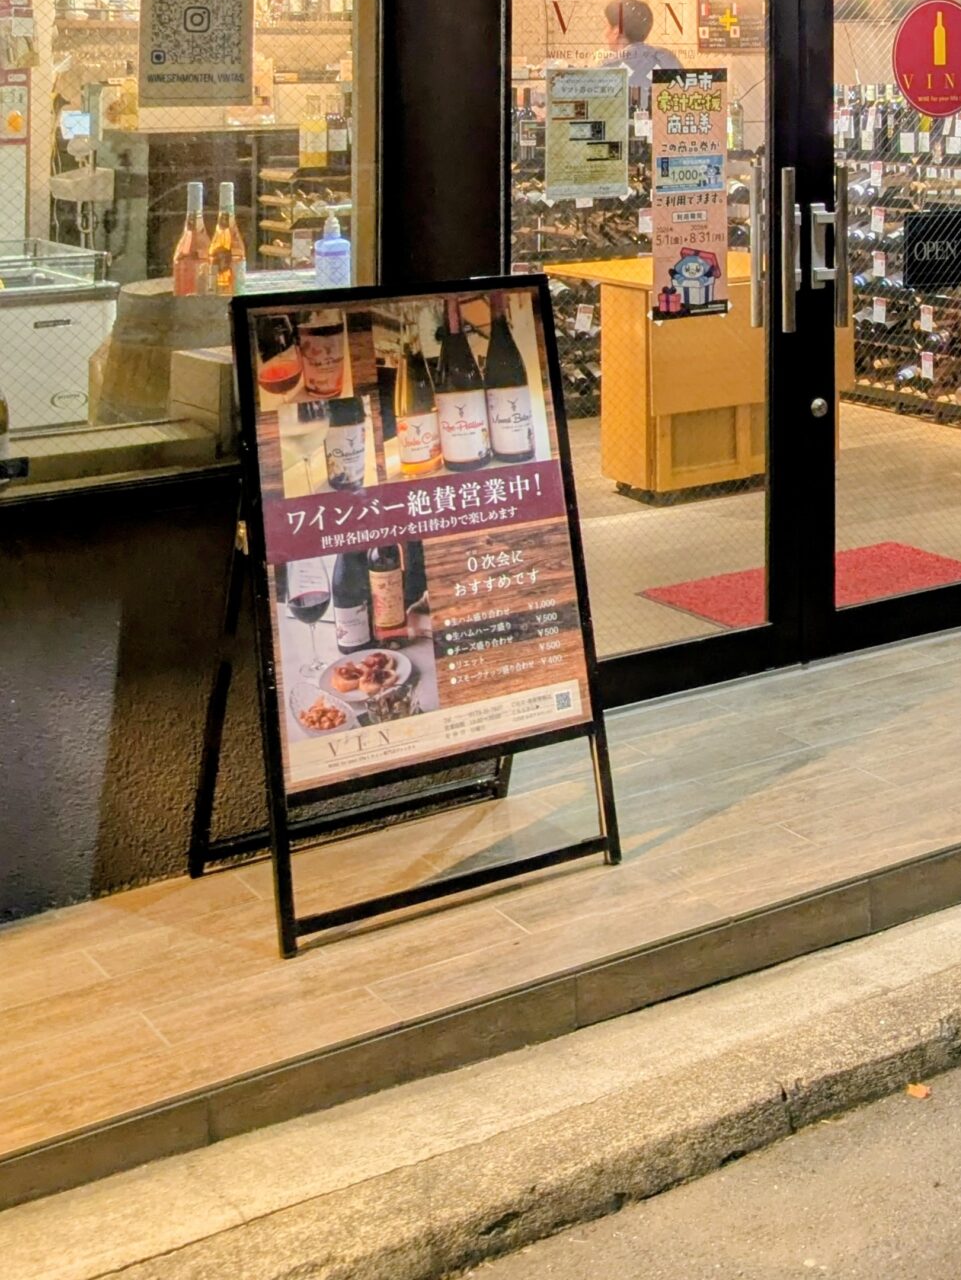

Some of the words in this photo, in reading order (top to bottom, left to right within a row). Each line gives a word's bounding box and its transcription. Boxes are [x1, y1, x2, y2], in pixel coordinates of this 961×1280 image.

[549, 50, 572, 60] WINE
[574, 50, 589, 60] for
[668, 72, 713, 91] 八戸市
[657, 89, 722, 113] 家計応援
[667, 112, 713, 135] 商品券
[661, 141, 720, 153] この商品券が
[656, 193, 723, 207] ご利用できます。
[914, 241, 957, 261] OPEN
[320, 506, 518, 549] 世界各国のワインを日替わりで楽しめます
[454, 568, 540, 597] おすすめです
